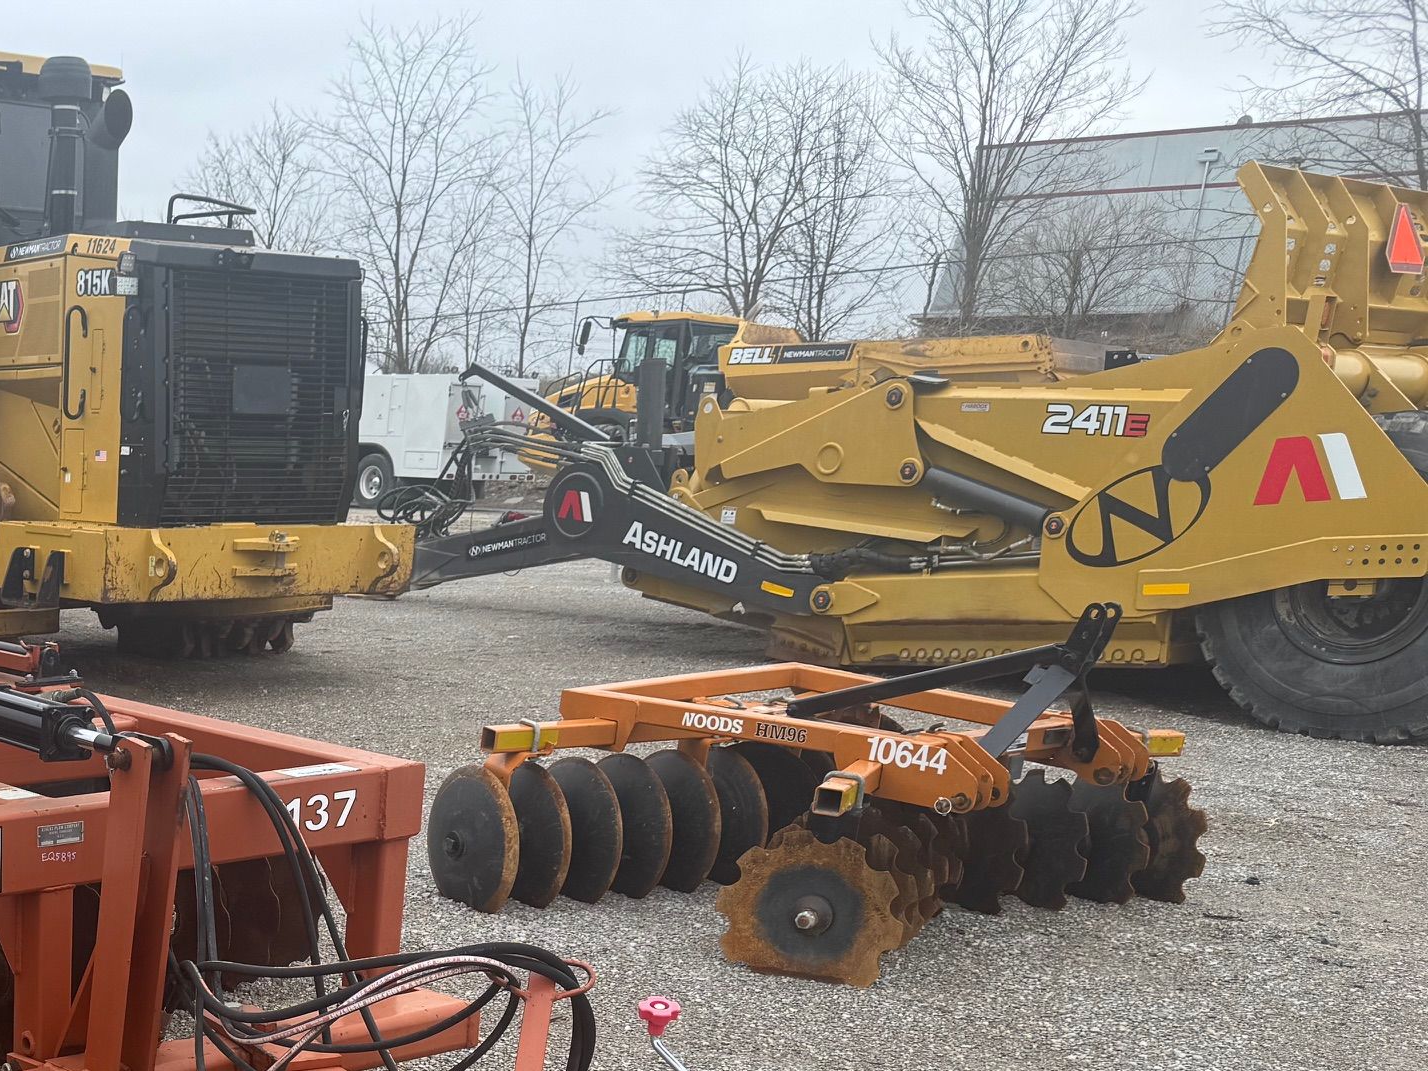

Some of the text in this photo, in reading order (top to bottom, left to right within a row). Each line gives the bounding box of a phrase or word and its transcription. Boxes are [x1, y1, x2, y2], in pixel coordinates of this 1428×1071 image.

[86, 238, 117, 254] 11624
[76, 269, 111, 296] 815K
[728, 347, 773, 365] BELL
[622, 520, 739, 585] ASHLAND
[755, 722, 808, 744] HM96
[866, 736, 948, 776] 10644
[287, 788, 358, 832] 137
